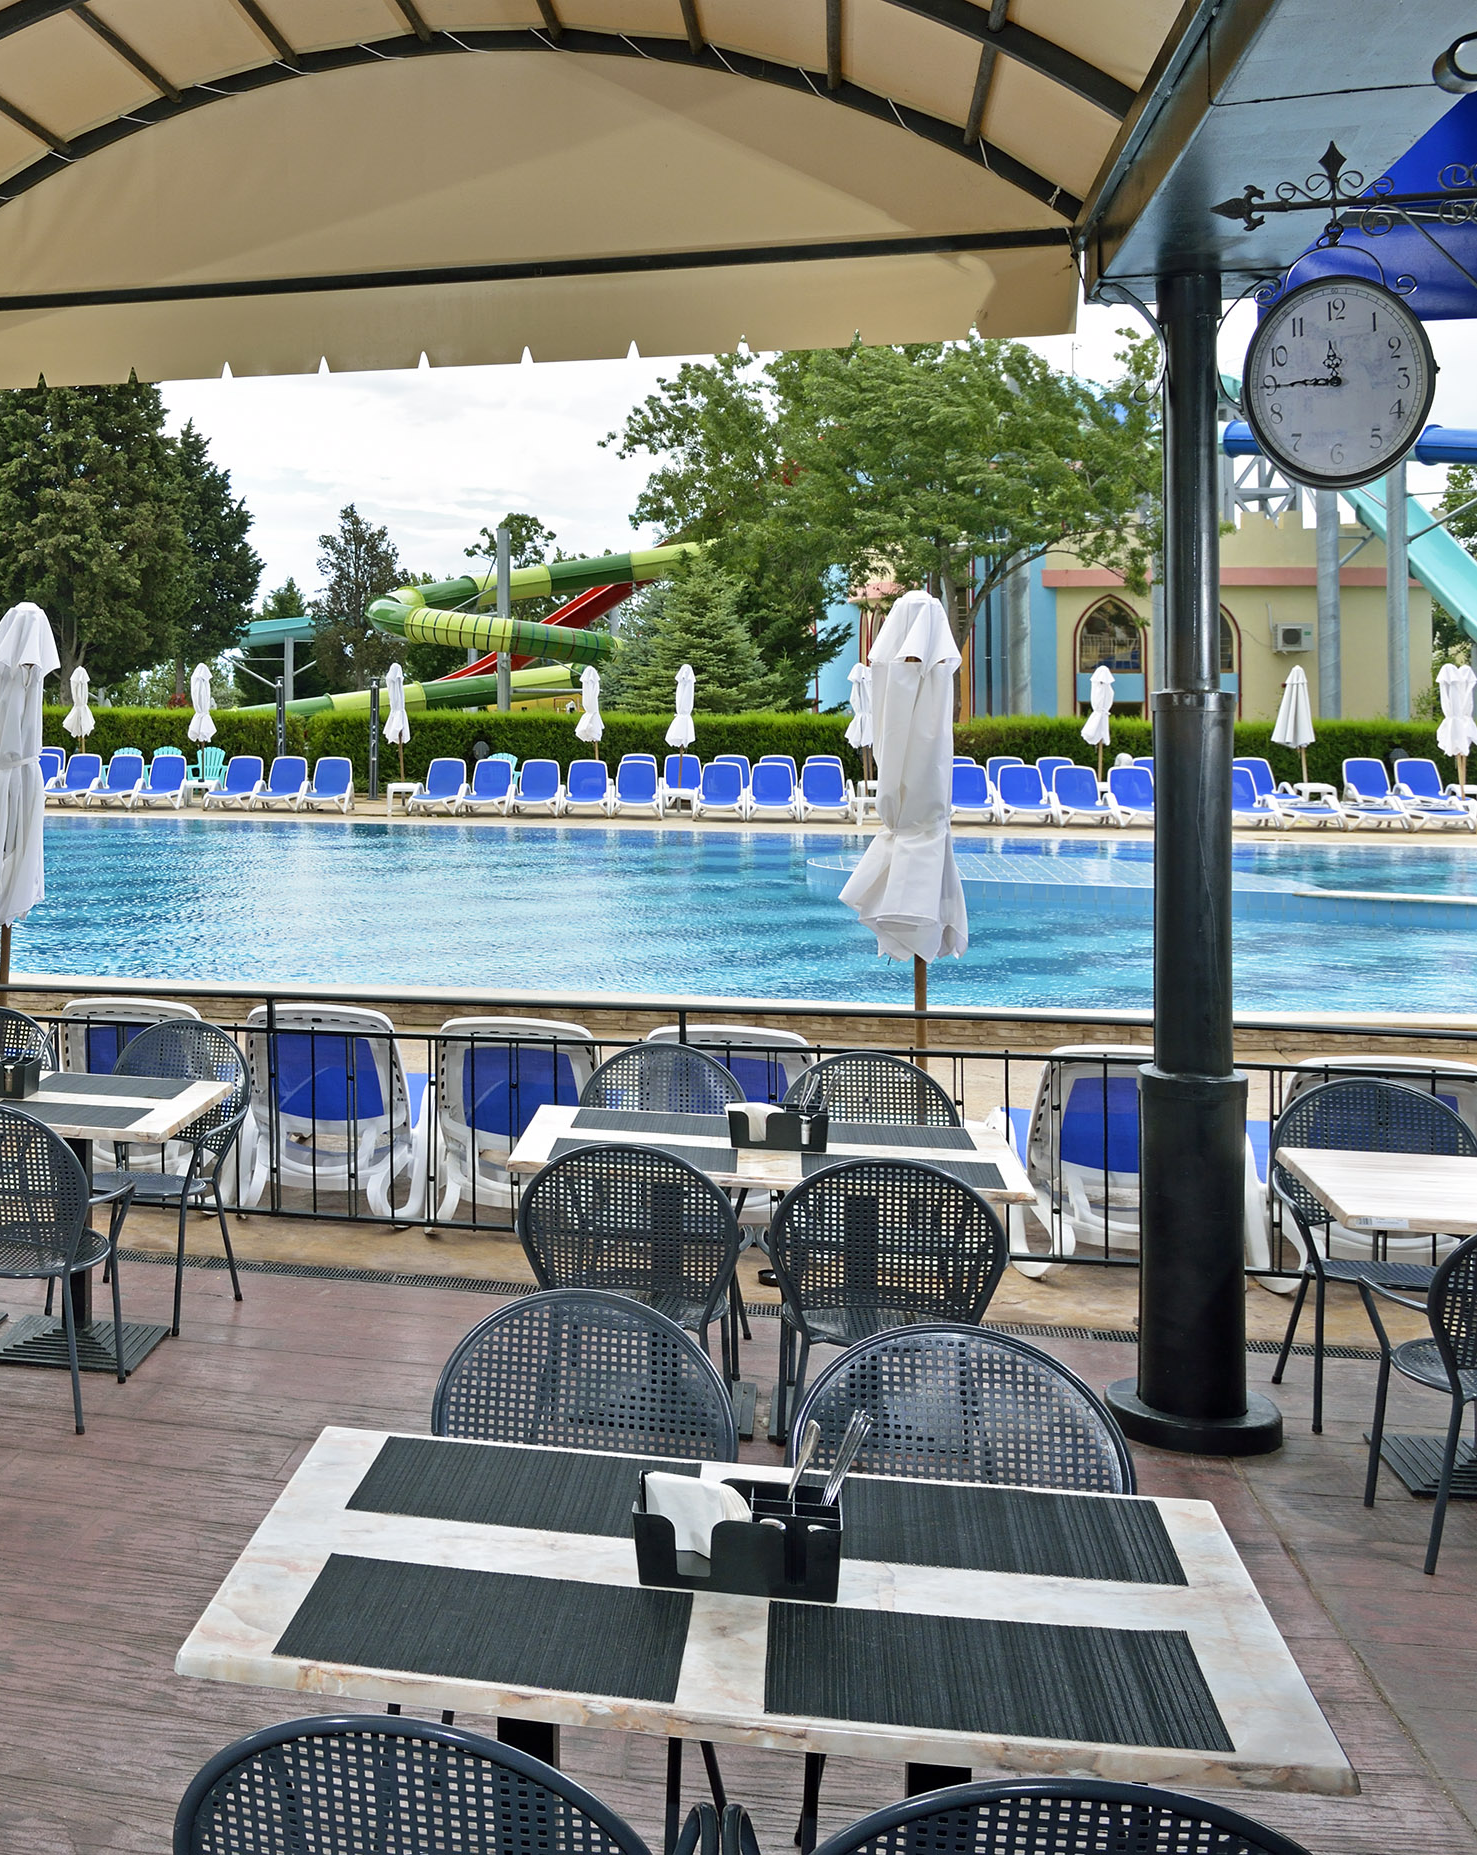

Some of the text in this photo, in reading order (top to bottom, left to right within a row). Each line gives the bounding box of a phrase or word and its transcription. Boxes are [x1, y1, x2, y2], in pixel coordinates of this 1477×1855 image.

[1327, 298, 1345, 321] 12
[1292, 317, 1304, 337] 11
[1372, 312, 1377, 332] 1
[1271, 345, 1288, 367] 10
[1388, 336, 1402, 358] 2
[1262, 375, 1277, 396] 9
[1397, 367, 1410, 389] 3
[1271, 403, 1283, 424] 8
[1389, 399, 1405, 420] 4
[1291, 433, 1302, 452] 7
[1370, 428, 1383, 449] 5
[1330, 443, 1345, 464] 6
